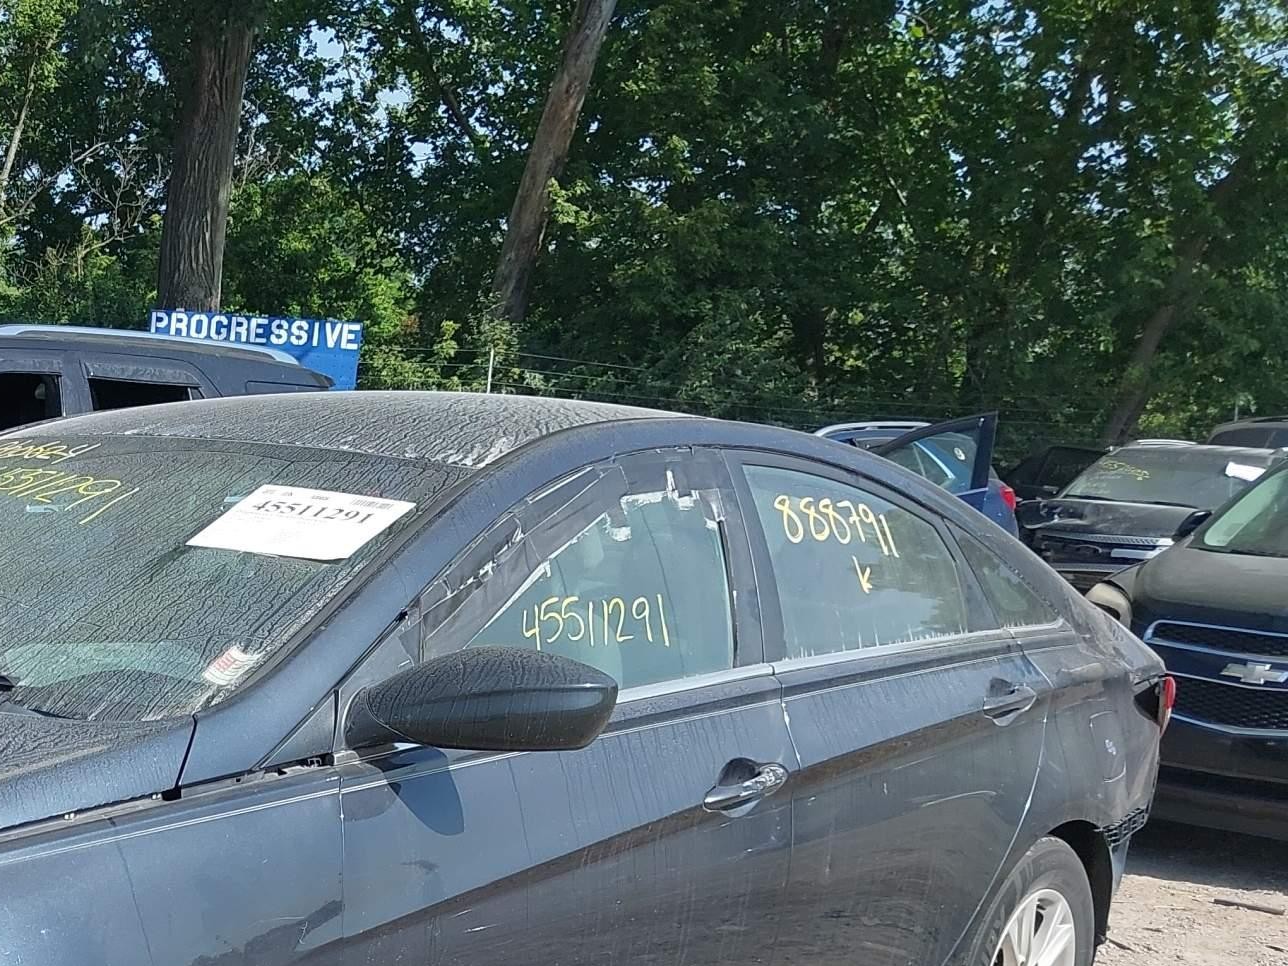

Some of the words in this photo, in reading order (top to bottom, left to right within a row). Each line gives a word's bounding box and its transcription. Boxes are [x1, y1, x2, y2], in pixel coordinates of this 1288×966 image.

[150, 311, 362, 350] PROGRESSIVE
[252, 499, 375, 523] 45511291
[774, 495, 899, 558] 888791
[523, 594, 670, 650] 45511291
